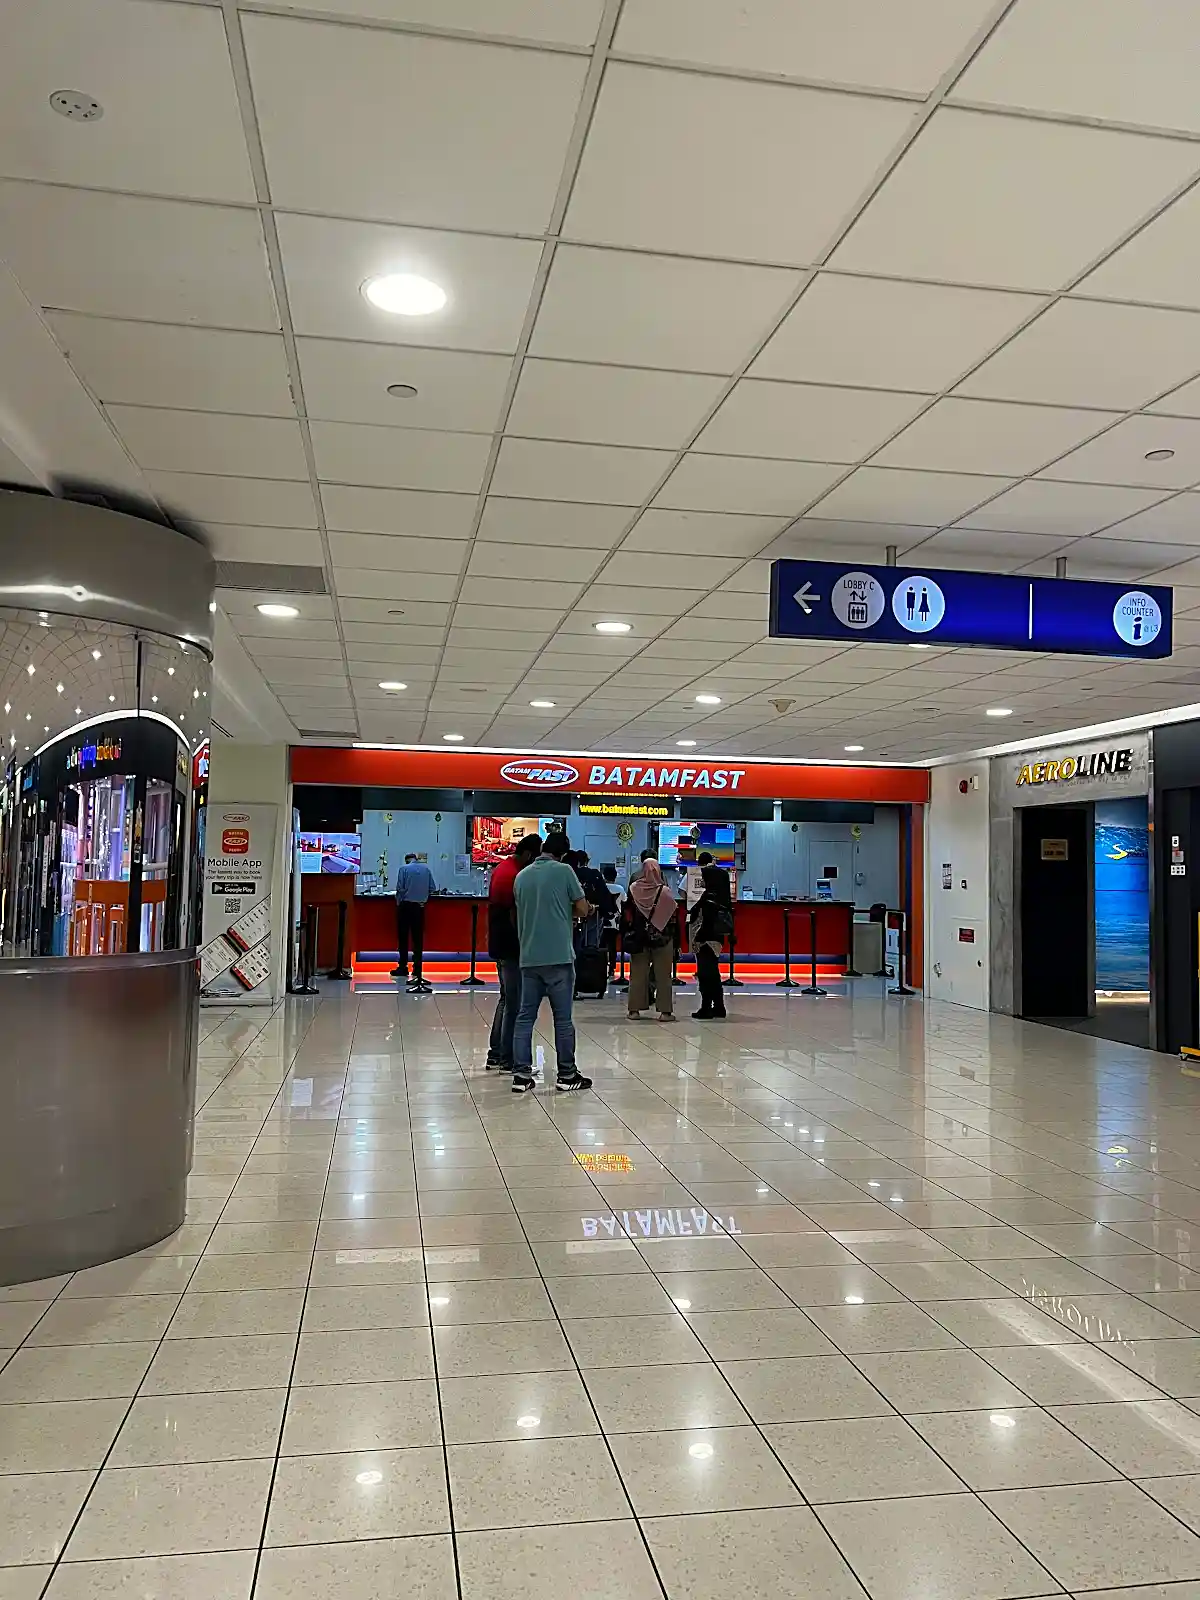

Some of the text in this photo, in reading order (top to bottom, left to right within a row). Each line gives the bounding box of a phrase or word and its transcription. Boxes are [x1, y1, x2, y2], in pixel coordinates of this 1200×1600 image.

[843, 579, 875, 590] LOBBY C
[1130, 598, 1146, 607] INFO
[1122, 606, 1154, 616] COUNTER
[1016, 749, 1134, 786] AEROLINE
[526, 769, 573, 781] FAST
[588, 766, 746, 789] BATAMFAST
[208, 858, 262, 868] Mobile App
